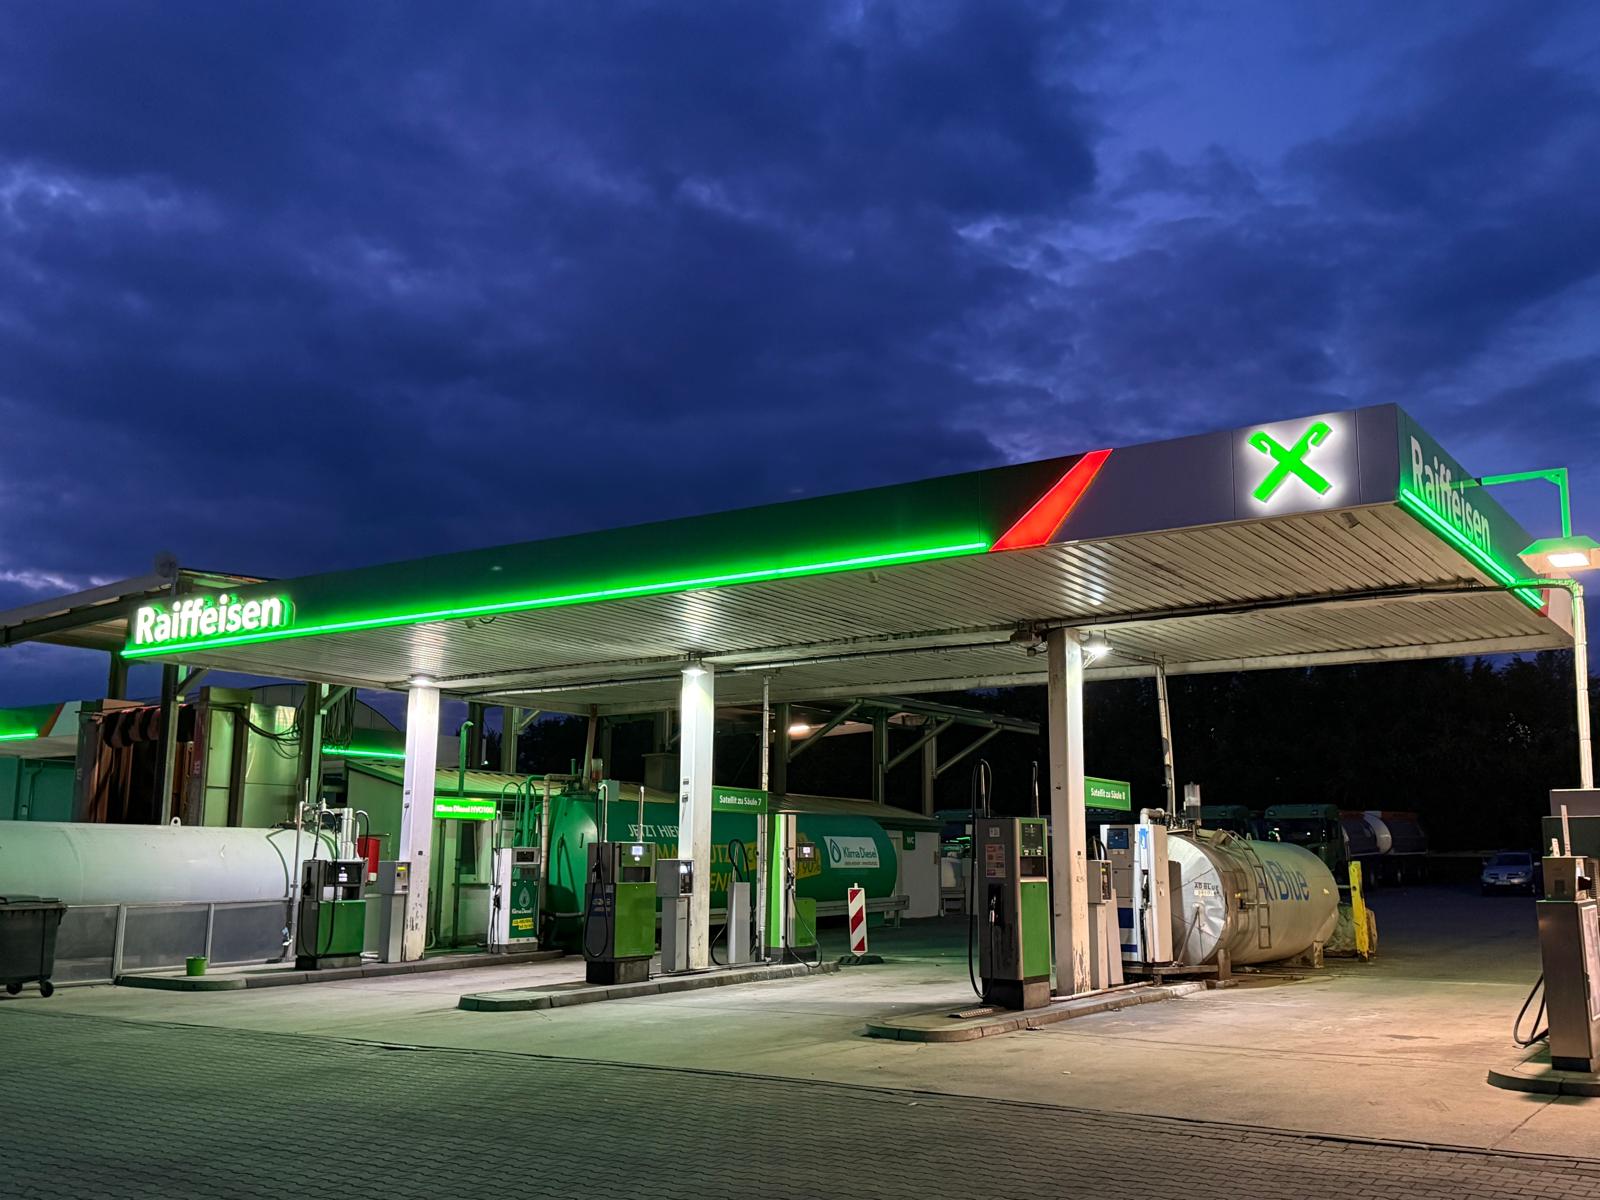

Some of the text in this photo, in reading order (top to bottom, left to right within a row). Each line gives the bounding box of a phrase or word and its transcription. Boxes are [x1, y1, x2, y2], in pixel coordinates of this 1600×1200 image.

[1410, 435, 1492, 557] Raiffeisen
[135, 593, 283, 645] Raiffeisen
[719, 794, 737, 804] Satellit
[737, 797, 744, 805] zu
[627, 823, 657, 838] JETZT
[907, 836, 915, 844] WC
